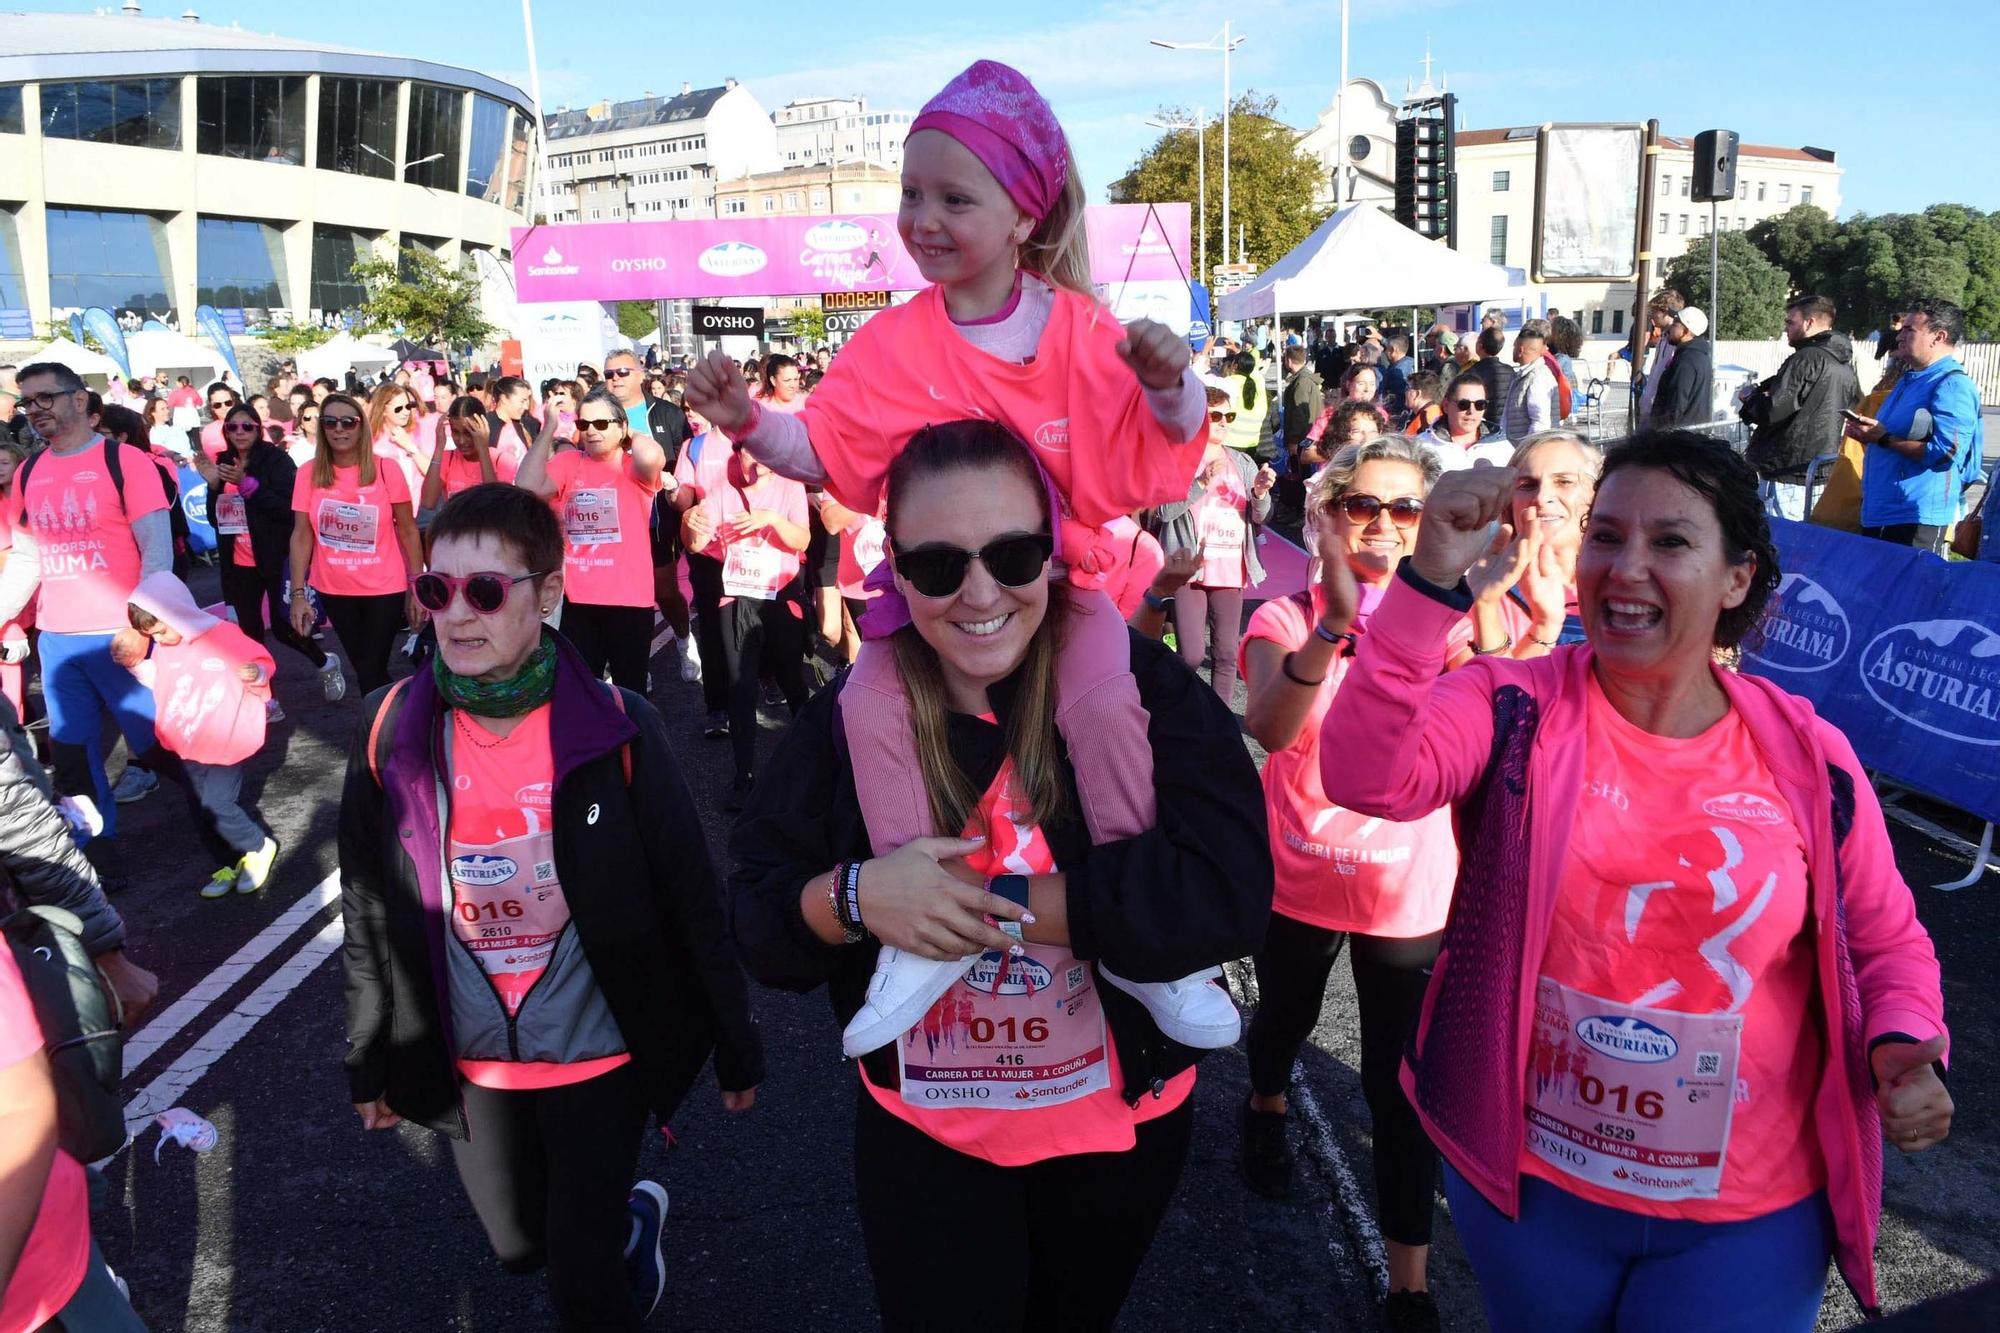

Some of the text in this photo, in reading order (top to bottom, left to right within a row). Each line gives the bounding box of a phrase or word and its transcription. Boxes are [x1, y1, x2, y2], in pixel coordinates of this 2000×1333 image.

[528, 265, 580, 277] Santander
[611, 257, 667, 272] OYSHO
[825, 291, 887, 309] 00:08:20
[703, 315, 755, 329] OYSHO
[535, 361, 577, 375] OYSH
[1040, 429, 1068, 443] AST
[189, 501, 207, 517] AST
[577, 512, 599, 521] 016
[336, 522, 359, 532] 016
[1218, 529, 1236, 538] 016
[51, 540, 104, 553] DORSAL
[43, 550, 109, 575] SUMA
[740, 567, 761, 578] 016
[1970, 666, 2000, 684] LEC
[520, 792, 552, 804] ASTUR
[1582, 780, 1629, 811] SHO
[1284, 831, 1331, 859] CARRERA
[1334, 847, 1350, 862] DE
[1353, 849, 1367, 863] LA
[452, 865, 513, 879] ASTURIANA
[461, 900, 524, 922] 016
[481, 927, 511, 937] 2610
[490, 939, 517, 947] MUJER
[967, 964, 1045, 985] ASTRIANA
[970, 1016, 1049, 1043] 016
[1582, 1022, 1670, 1057] ASTURIANA
[996, 1054, 1024, 1065] 416
[925, 1057, 1087, 1079] CARRERA DE LA MUJER A CORUÑA
[925, 1077, 1089, 1099] OYSHO Santander
[1579, 1075, 1665, 1120] 016
[1530, 1112, 1569, 1136] CARRERA
[1572, 1129, 1584, 1144] DE
[1587, 1136, 1598, 1148] LA
[1601, 1142, 1638, 1158] MUJER
[1648, 1155, 1655, 1163] A
[1659, 1153, 1699, 1166] CORUÑA
[1594, 1122, 1635, 1141] 4529
[1528, 1128, 1696, 1189] OYSHO Santander
